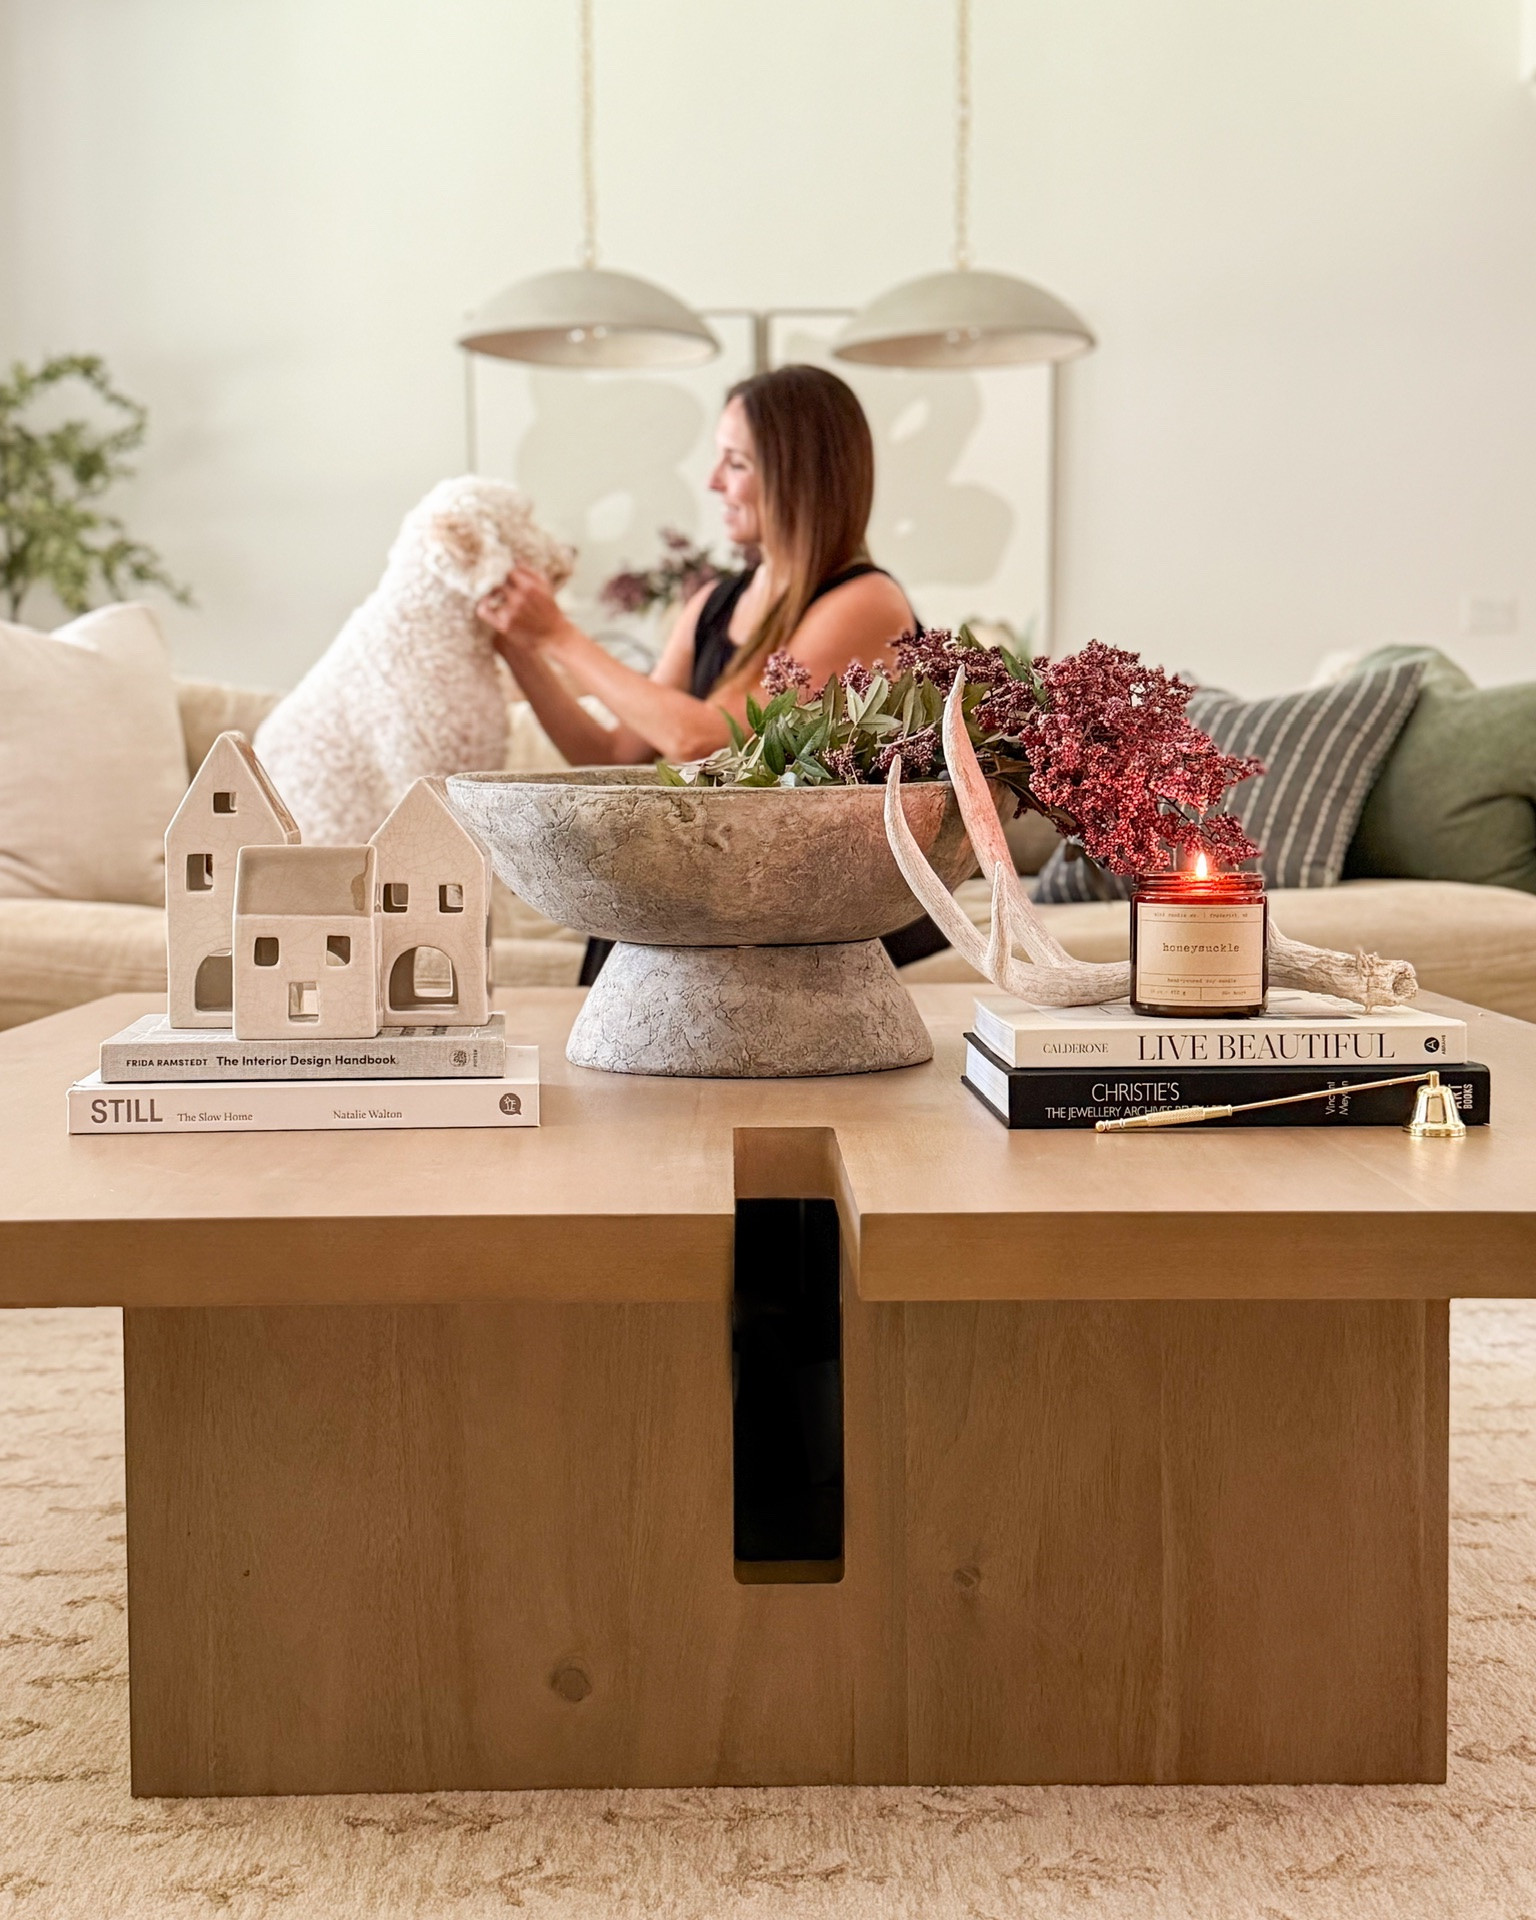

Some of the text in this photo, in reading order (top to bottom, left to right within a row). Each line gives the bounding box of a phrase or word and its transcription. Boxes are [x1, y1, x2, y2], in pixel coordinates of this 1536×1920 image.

[1162, 943, 1240, 954] honeysuckle
[1042, 1043, 1109, 1055] CALDERONE
[1138, 1033, 1396, 1061] LIVE BEAUTIFUL
[126, 1058, 208, 1067] FRIDA RAMSTEDT
[216, 1056, 238, 1066] The
[242, 1055, 287, 1066] Interior
[290, 1055, 332, 1068] Design
[1091, 1082, 1180, 1102] CHRISTIE'S
[1325, 1081, 1336, 1115] Vincnt
[1339, 1080, 1351, 1116] Meyn
[1463, 1083, 1473, 1110] BOOKS
[91, 1098, 163, 1123] STILL
[177, 1112, 253, 1122] The Slow Home
[333, 1109, 403, 1120] Natalie Walton
[1045, 1107, 1066, 1119] THE
[1067, 1105, 1123, 1120] JEWELLERY
